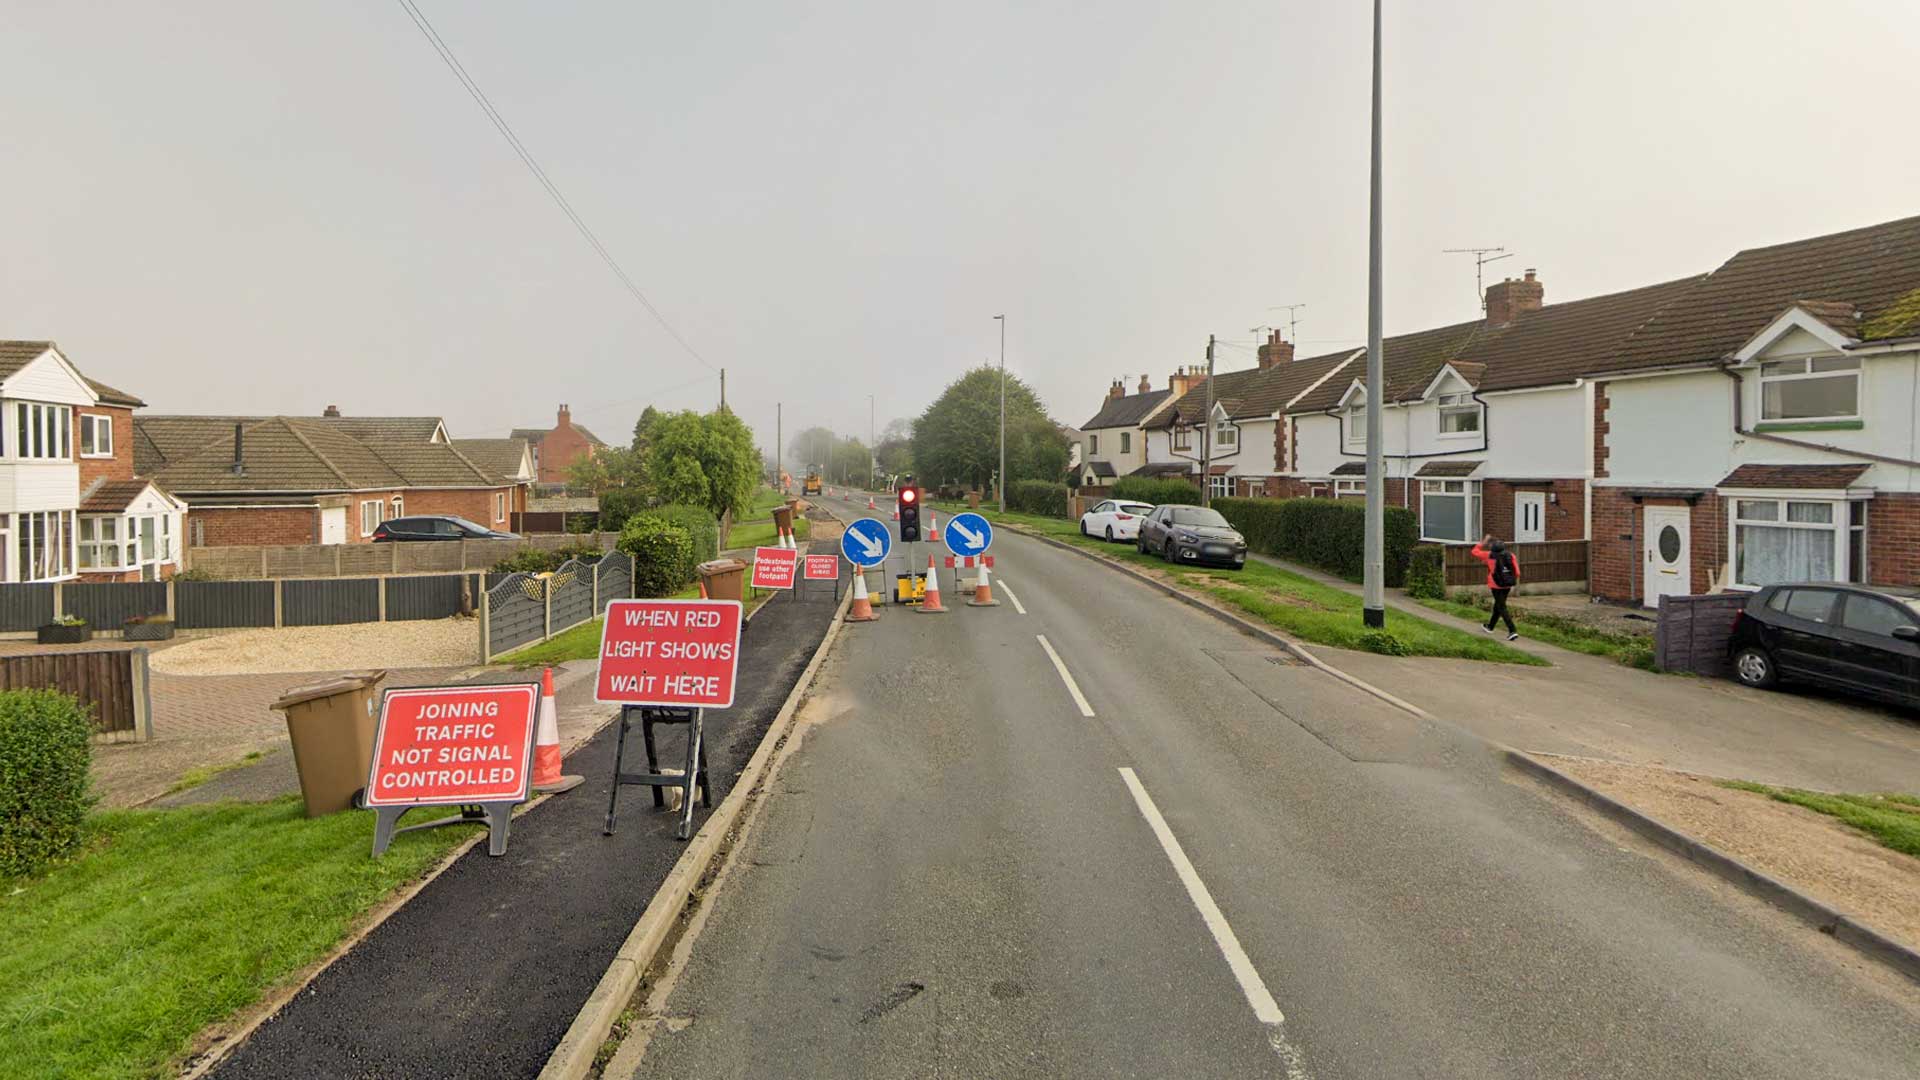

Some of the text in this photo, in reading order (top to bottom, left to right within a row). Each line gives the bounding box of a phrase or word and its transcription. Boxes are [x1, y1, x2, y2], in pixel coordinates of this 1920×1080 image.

[755, 557, 793, 565] Pedestrians
[625, 610, 721, 628] WHEN RED
[605, 641, 732, 660] LIGHT SHOWS
[610, 675, 720, 697] WAIT HERE
[416, 702, 499, 719] JOINING
[415, 723, 495, 742] TRAFFIC
[391, 745, 512, 765] NOT SIGNAL
[382, 767, 515, 789] CONTROLLED
